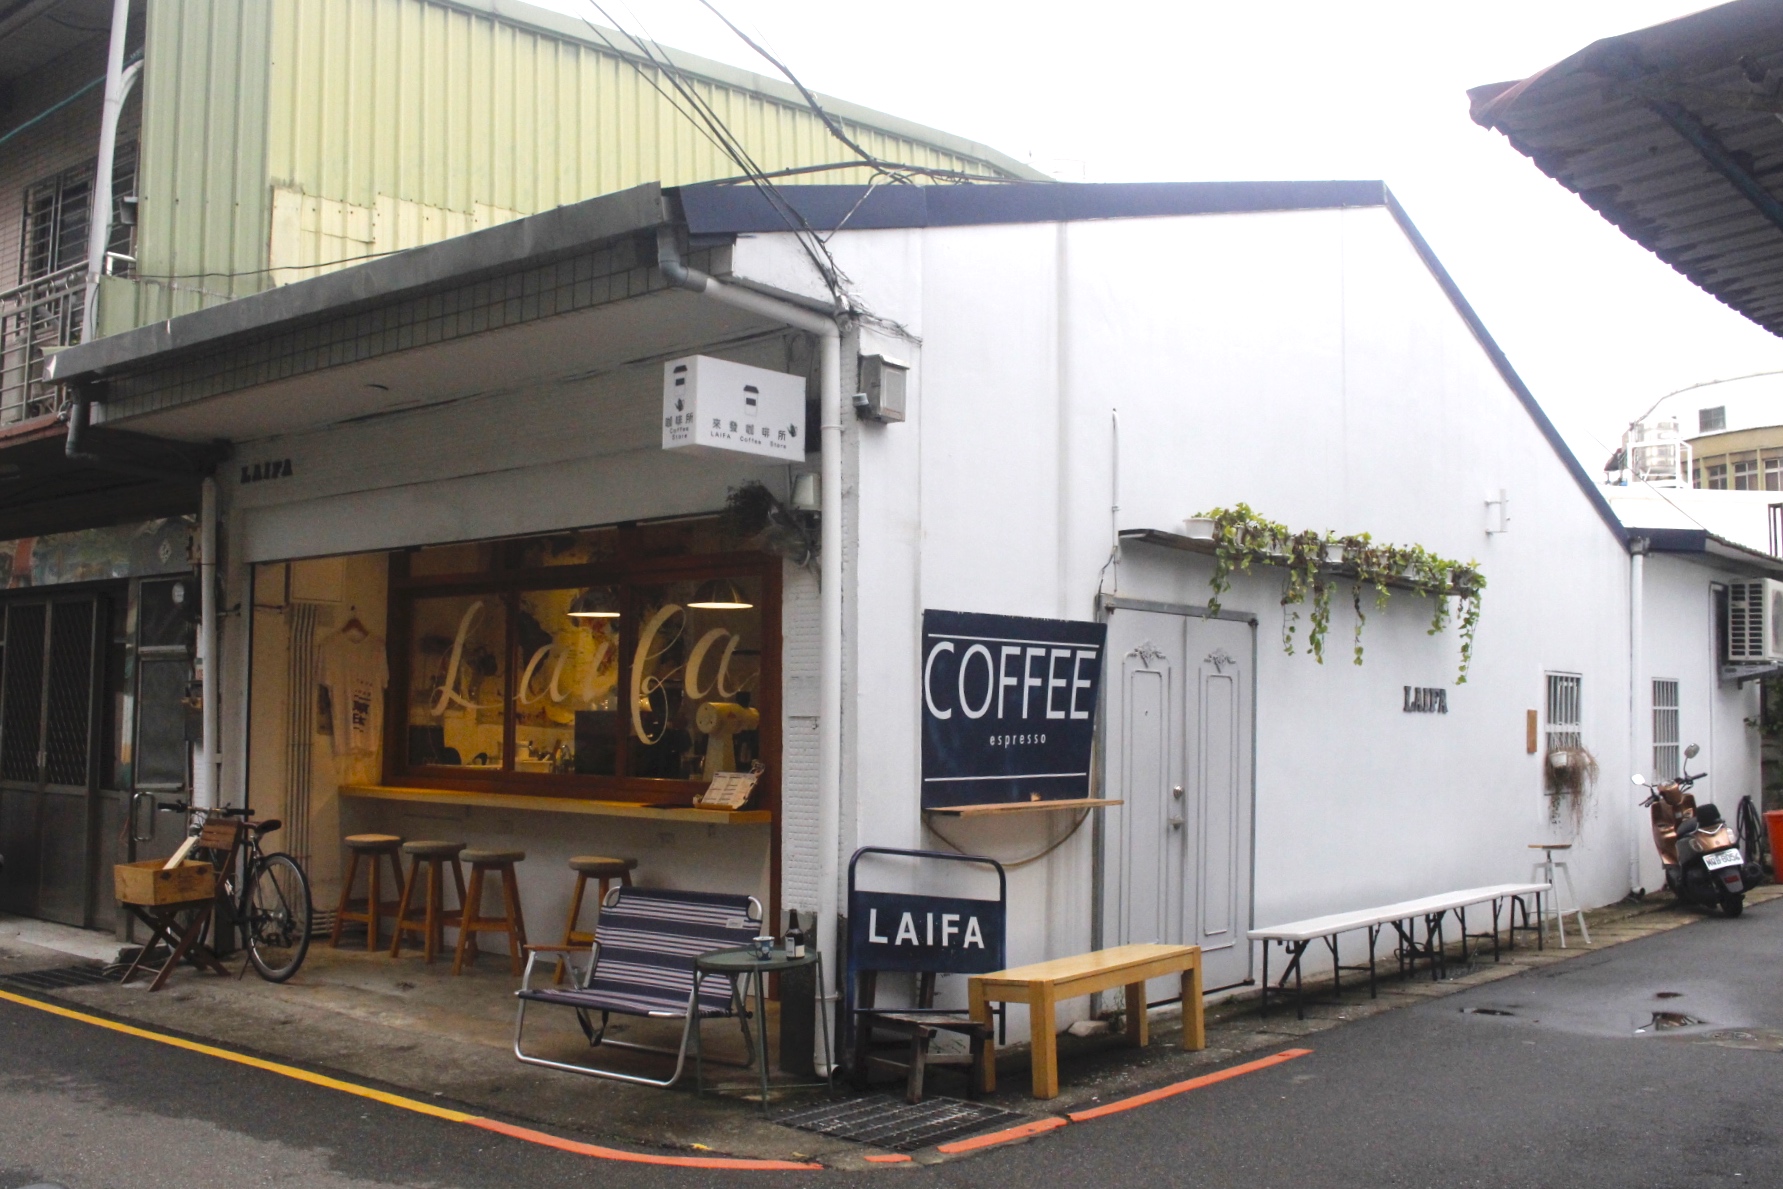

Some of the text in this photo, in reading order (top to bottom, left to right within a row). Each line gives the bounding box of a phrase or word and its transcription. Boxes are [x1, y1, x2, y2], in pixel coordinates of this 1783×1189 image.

[665, 412, 694, 427] 咖啡所
[669, 426, 690, 435] Coffee
[711, 418, 787, 441] 來發咖啡所
[710, 431, 787, 450] LAIFA Coffee Store
[240, 458, 293, 484] LAIFA
[924, 641, 1097, 720] COFFEE
[1402, 685, 1449, 714] LAIFA
[989, 733, 1047, 749] espresso
[868, 908, 985, 949] LAIFA
